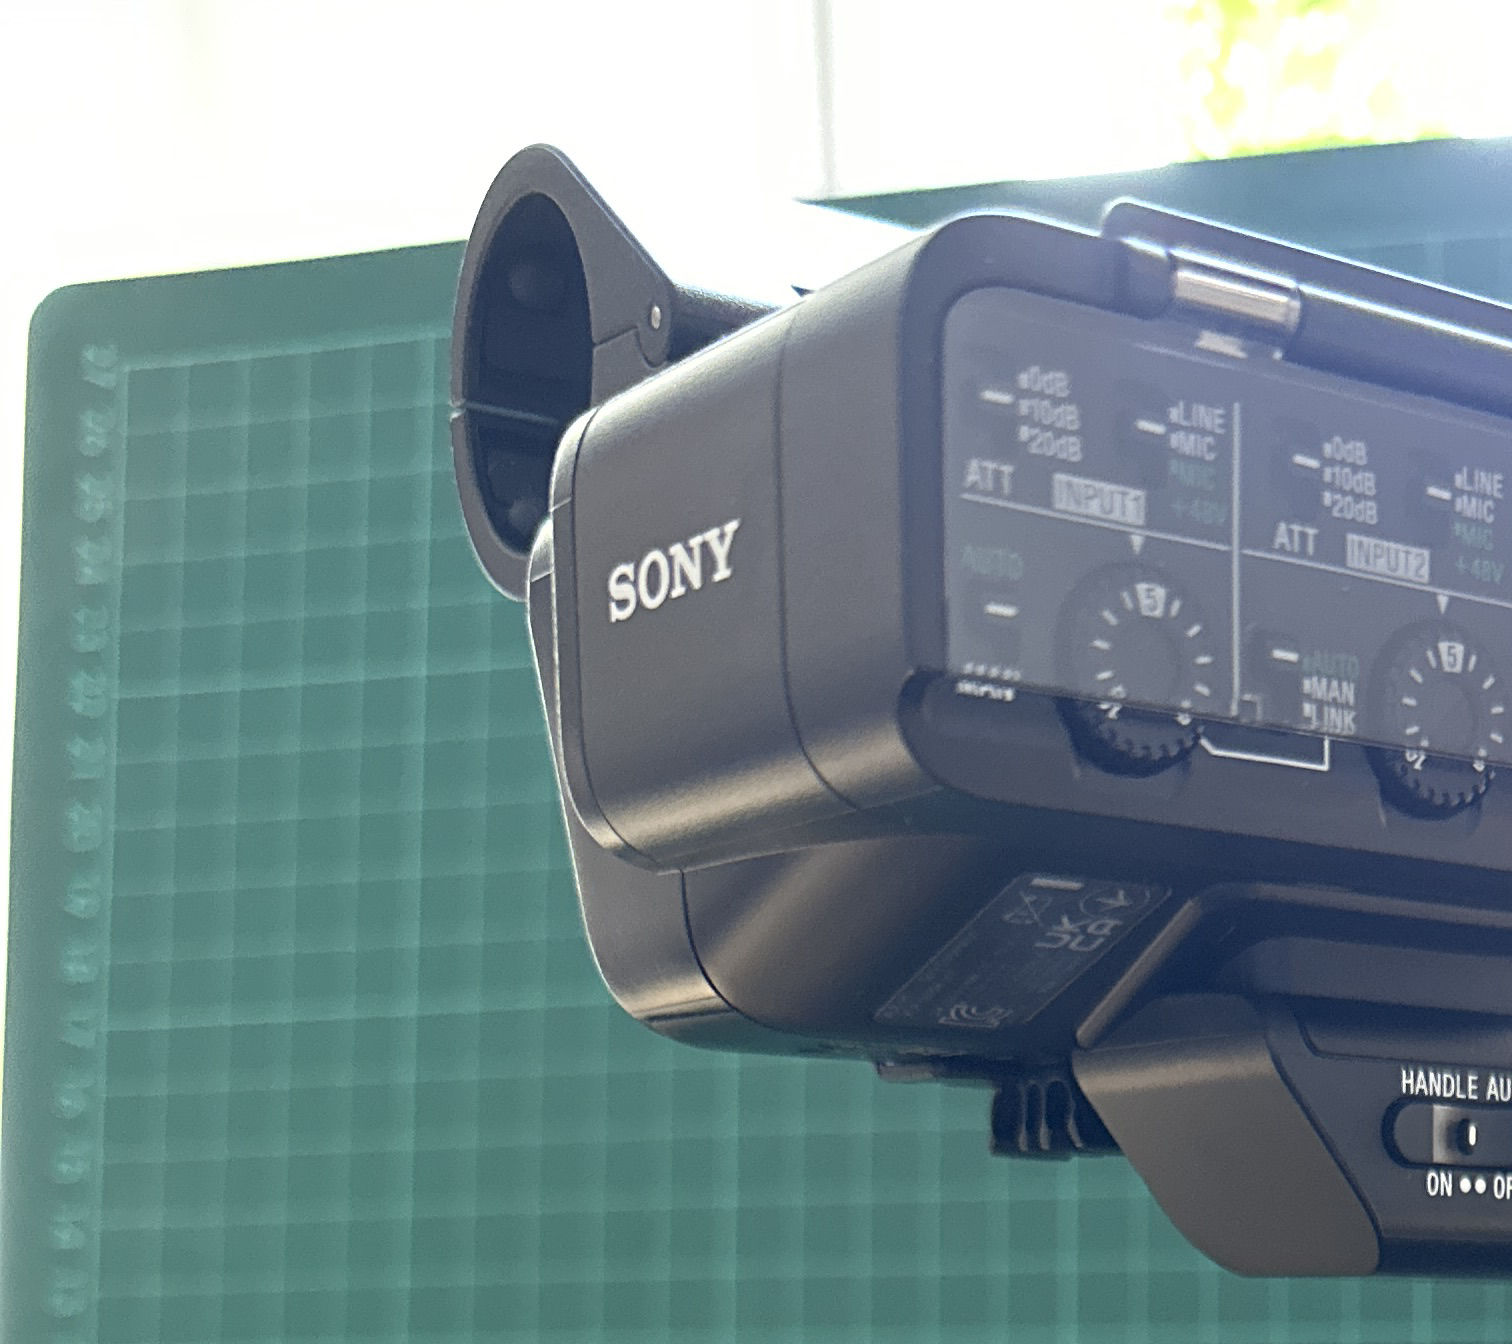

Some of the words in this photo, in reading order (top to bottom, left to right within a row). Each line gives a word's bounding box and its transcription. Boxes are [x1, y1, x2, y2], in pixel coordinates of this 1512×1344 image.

[964, 457, 1014, 496] ATT
[1462, 466, 1503, 498] LINE
[1272, 521, 1319, 556] ATT
[1349, 535, 1427, 581] INPUT2
[608, 518, 741, 623] SONY
[1312, 676, 1355, 706] MAN
[1402, 1069, 1478, 1100] HANDLE
[1427, 1172, 1452, 1197] ON
